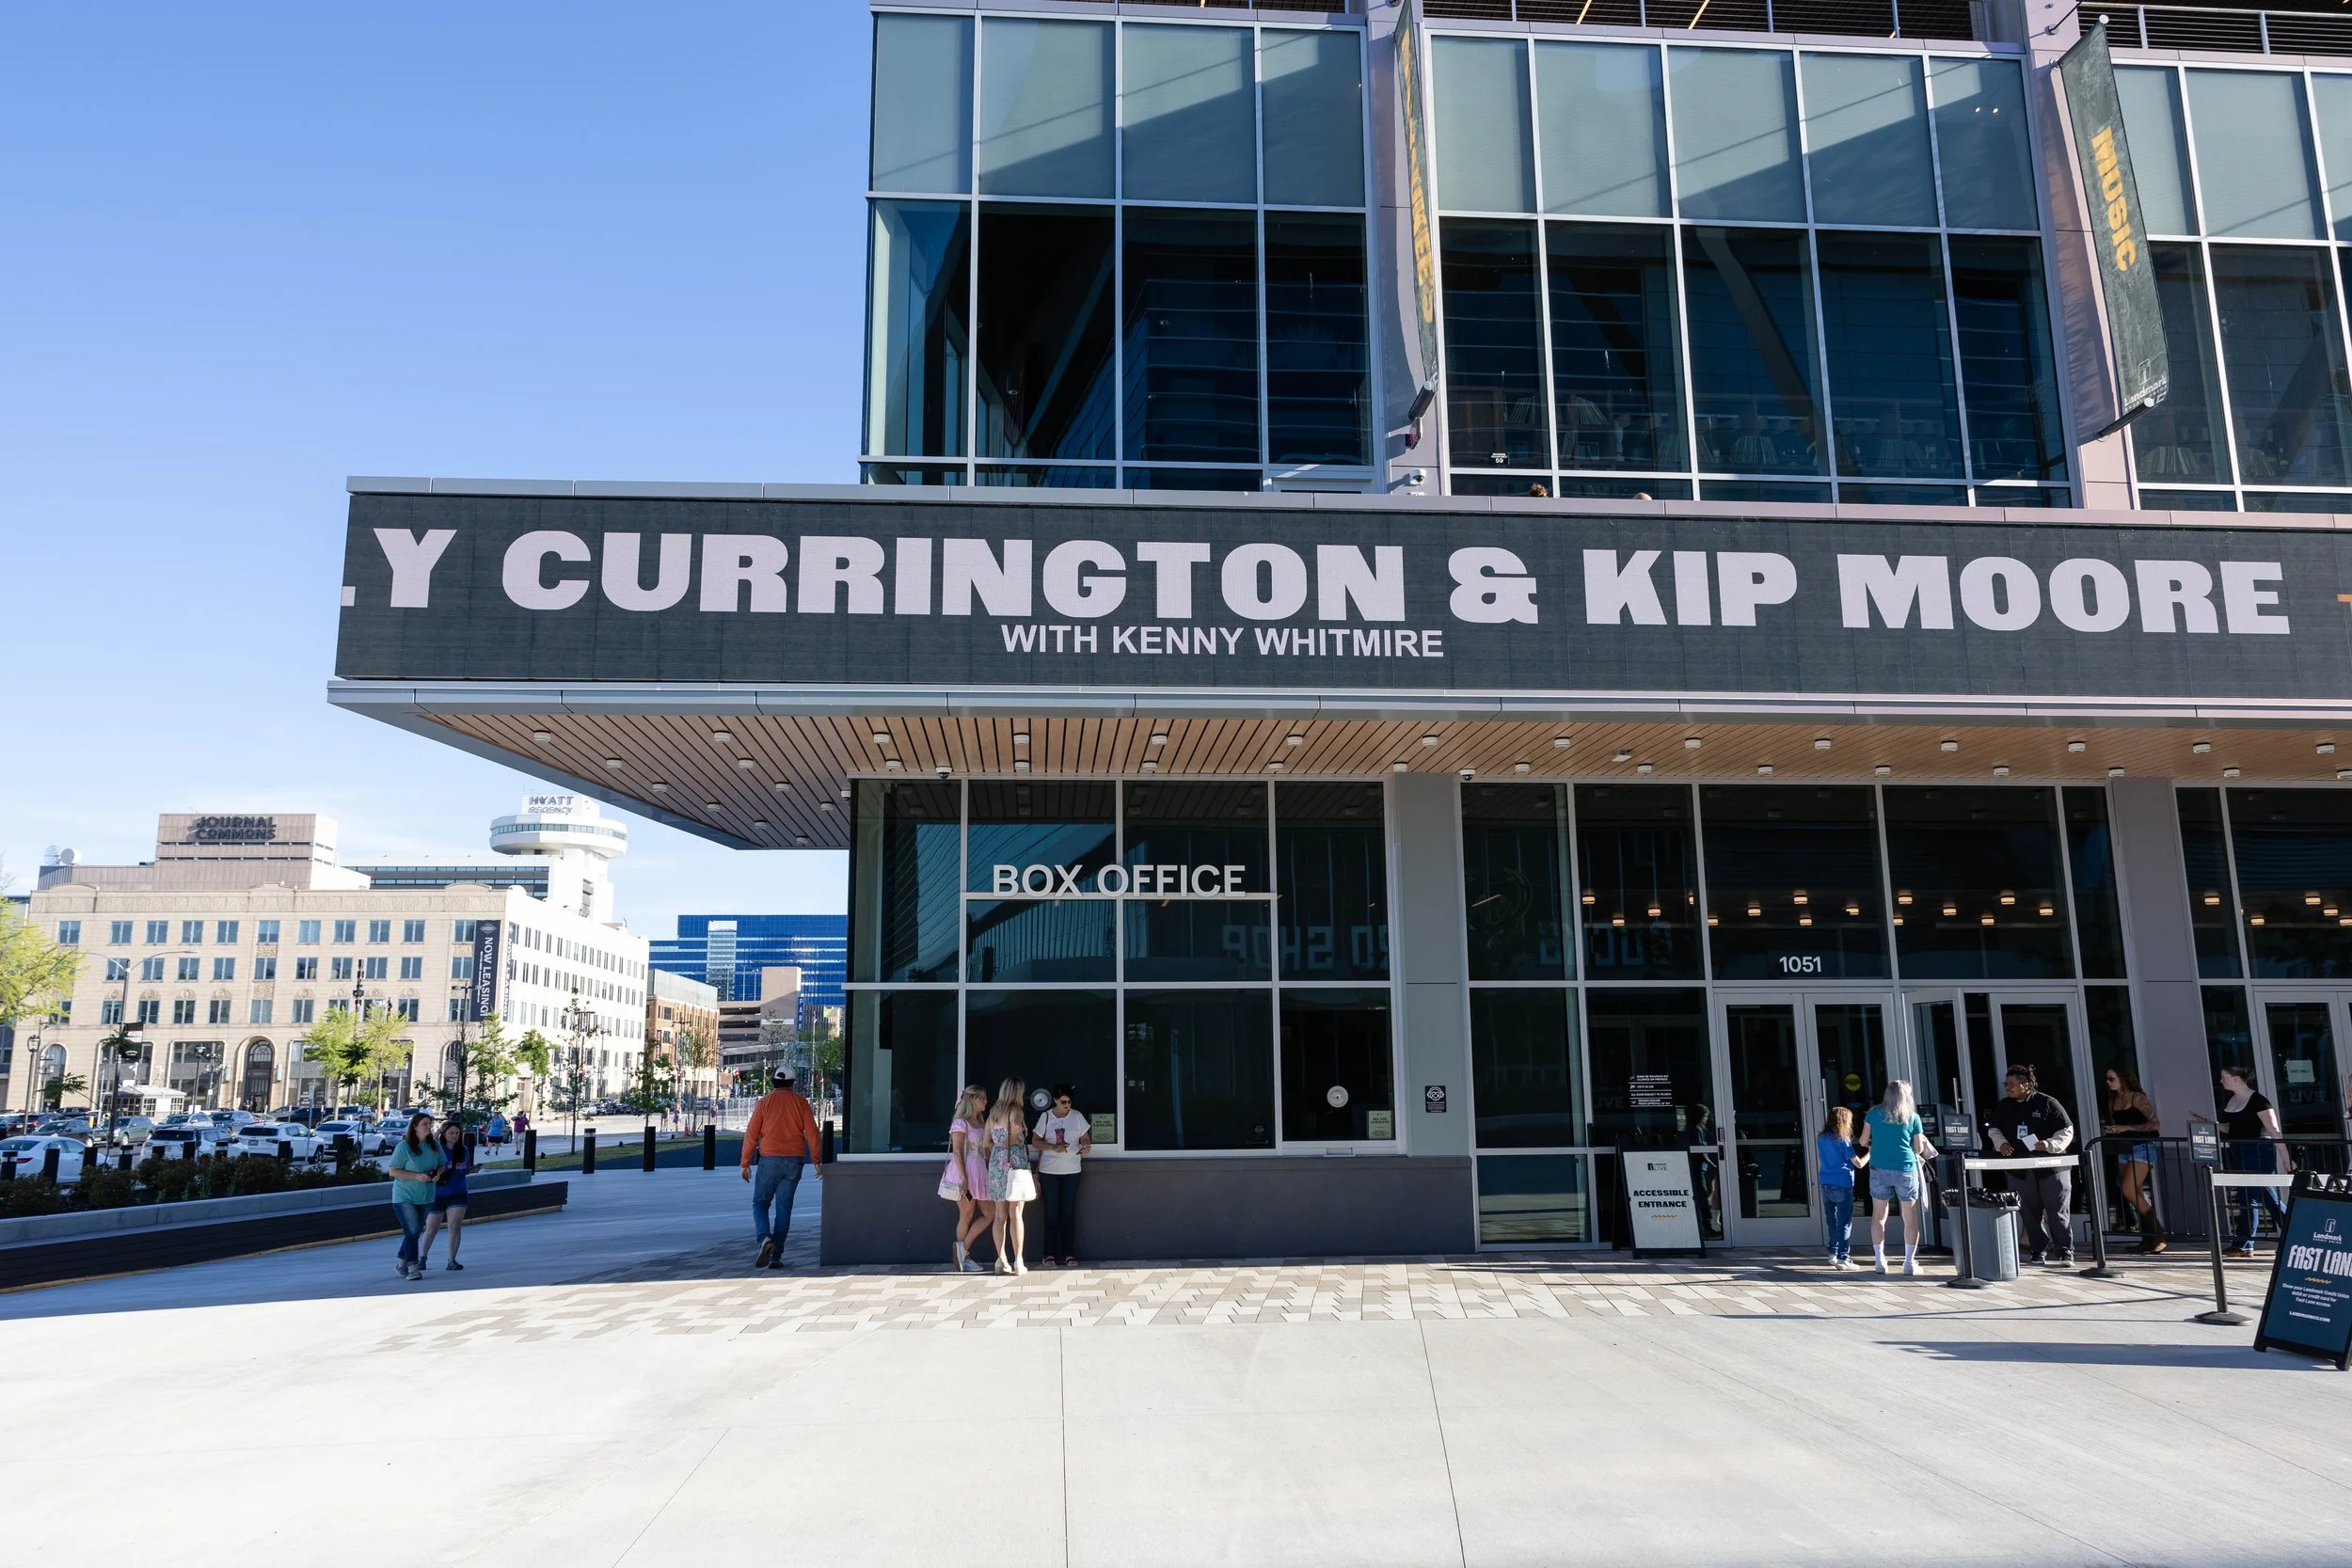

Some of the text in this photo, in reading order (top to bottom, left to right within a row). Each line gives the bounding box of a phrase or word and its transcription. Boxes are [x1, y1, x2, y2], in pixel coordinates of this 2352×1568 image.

[2091, 124, 2137, 272] MUSIC
[502, 530, 1406, 622] CURRINGTON
[1448, 546, 1539, 625] &
[1582, 548, 1798, 626] KIP
[1836, 553, 2291, 635] MOORE
[1000, 624, 1444, 657] WITH KENNY WHITMIRE
[529, 796, 574, 805] HYATT
[195, 829, 277, 839] COMMONS
[196, 816, 277, 828] JOURNAL
[993, 864, 1246, 897] BOX OFFICE
[484, 937, 493, 963] NOW
[1779, 956, 1821, 973] 1051
[480, 966, 491, 1017] LEASING!
[2313, 1231, 2343, 1242] Landmark
[2287, 1244, 2324, 1272] FAST
[2303, 1286, 2323, 1294] Landmark
